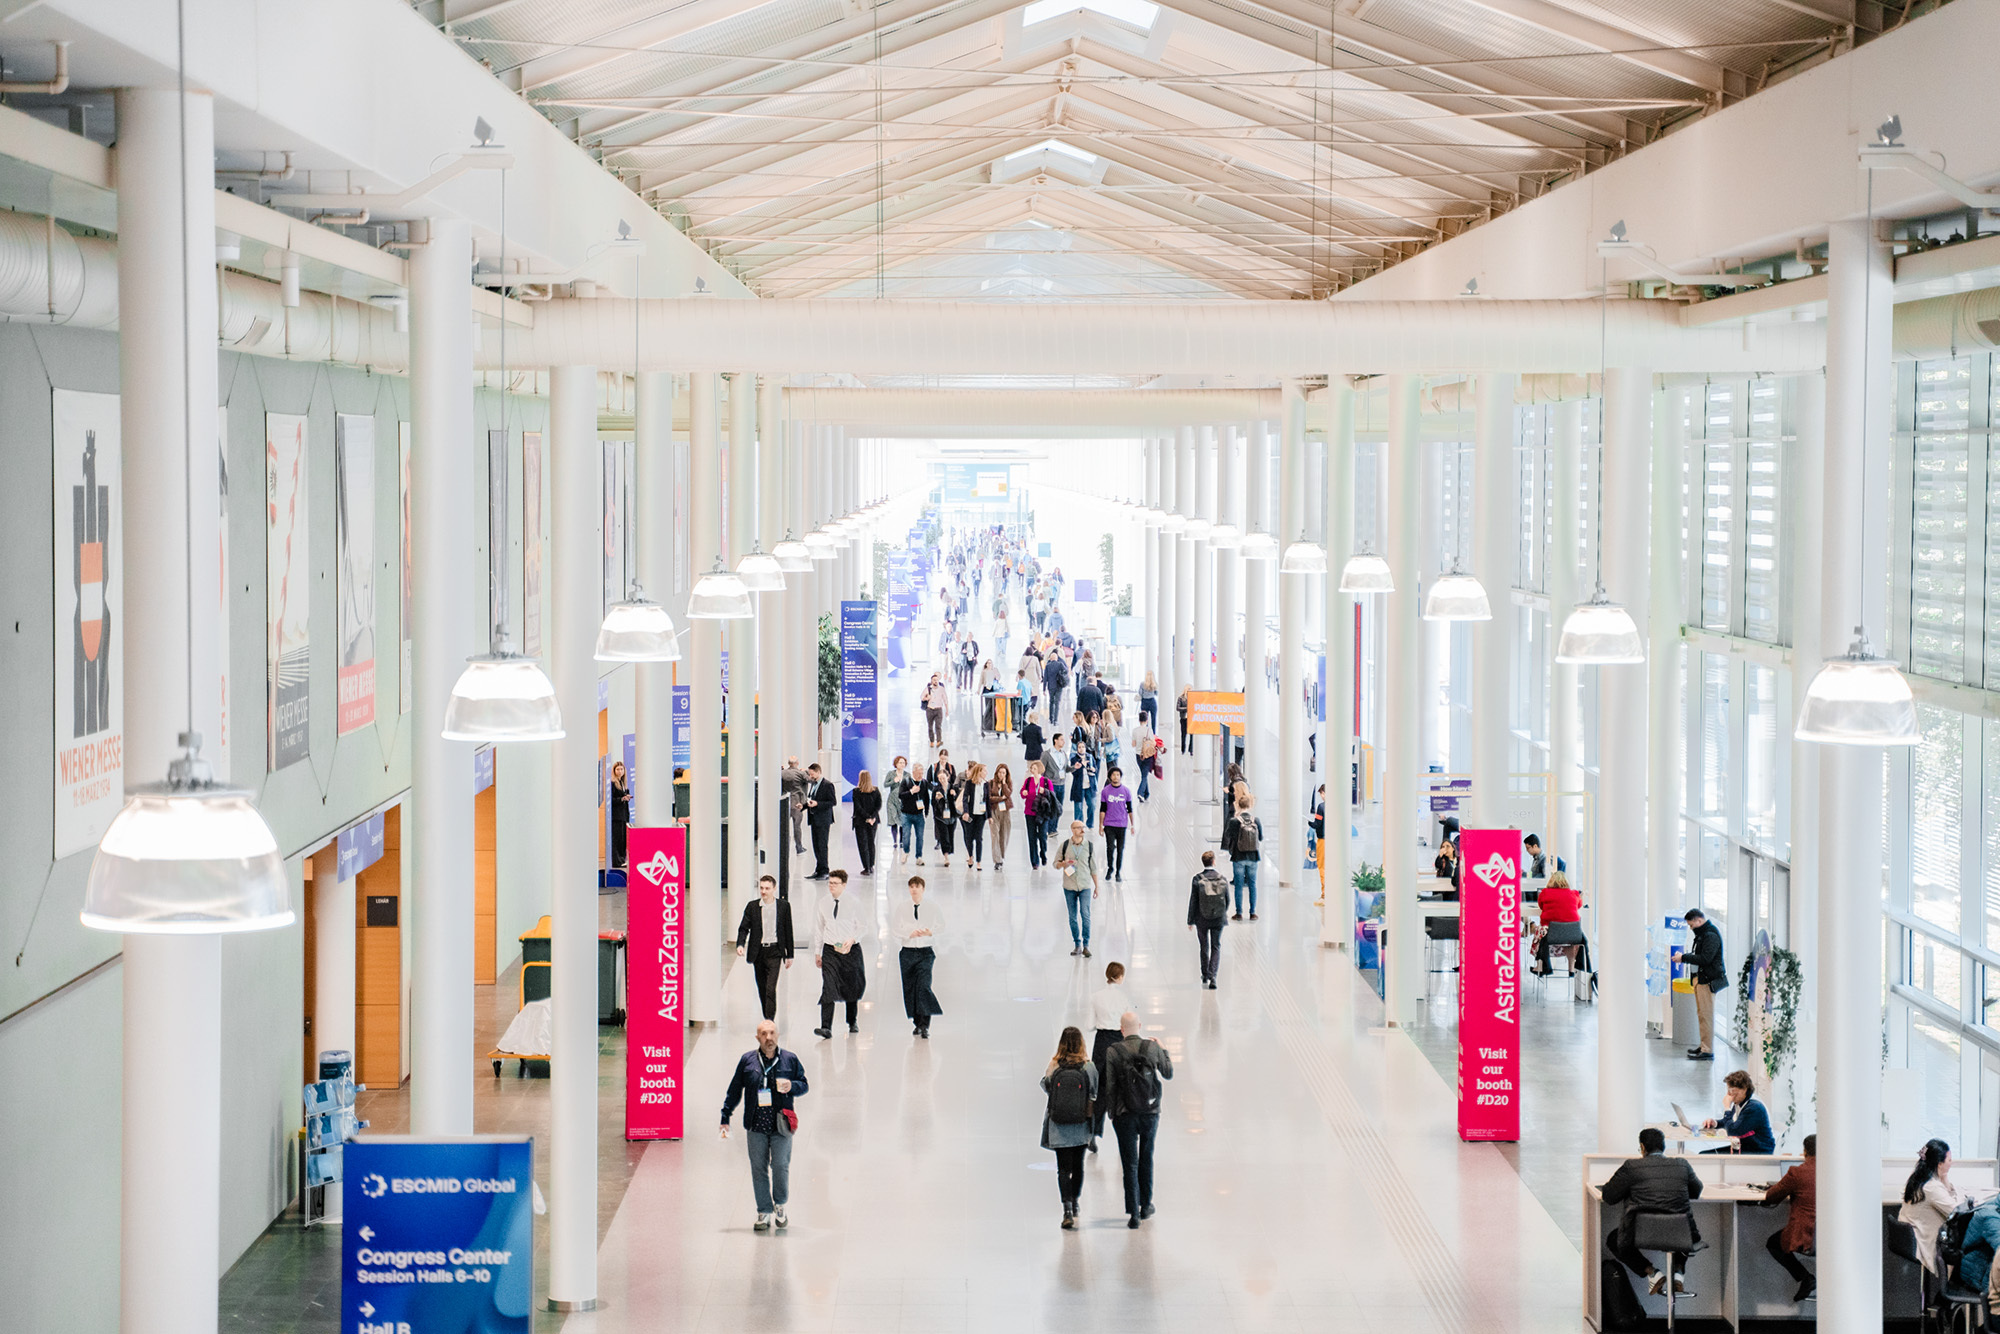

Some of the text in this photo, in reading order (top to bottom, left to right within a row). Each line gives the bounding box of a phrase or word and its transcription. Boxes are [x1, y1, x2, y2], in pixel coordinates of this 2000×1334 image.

[680, 697, 688, 709] 9
[60, 734, 121, 787] WIENER MESSE
[658, 882, 679, 1021] AstraZeneca
[1494, 884, 1516, 1024] AstraZeneca
[642, 1046, 671, 1057] Visit
[1479, 1048, 1508, 1059] Visit
[646, 1064, 667, 1073] our
[1482, 1066, 1504, 1074] our
[640, 1077, 676, 1088] booth
[1476, 1078, 1512, 1090] booth
[640, 1093, 672, 1104] #D20
[1477, 1094, 1508, 1105] #D20
[391, 1178, 516, 1193] ESCMID Global
[357, 1248, 512, 1268] Congress Center
[357, 1270, 414, 1284] Session
[417, 1270, 453, 1283] Halls
[358, 1322, 394, 1334] Hall
